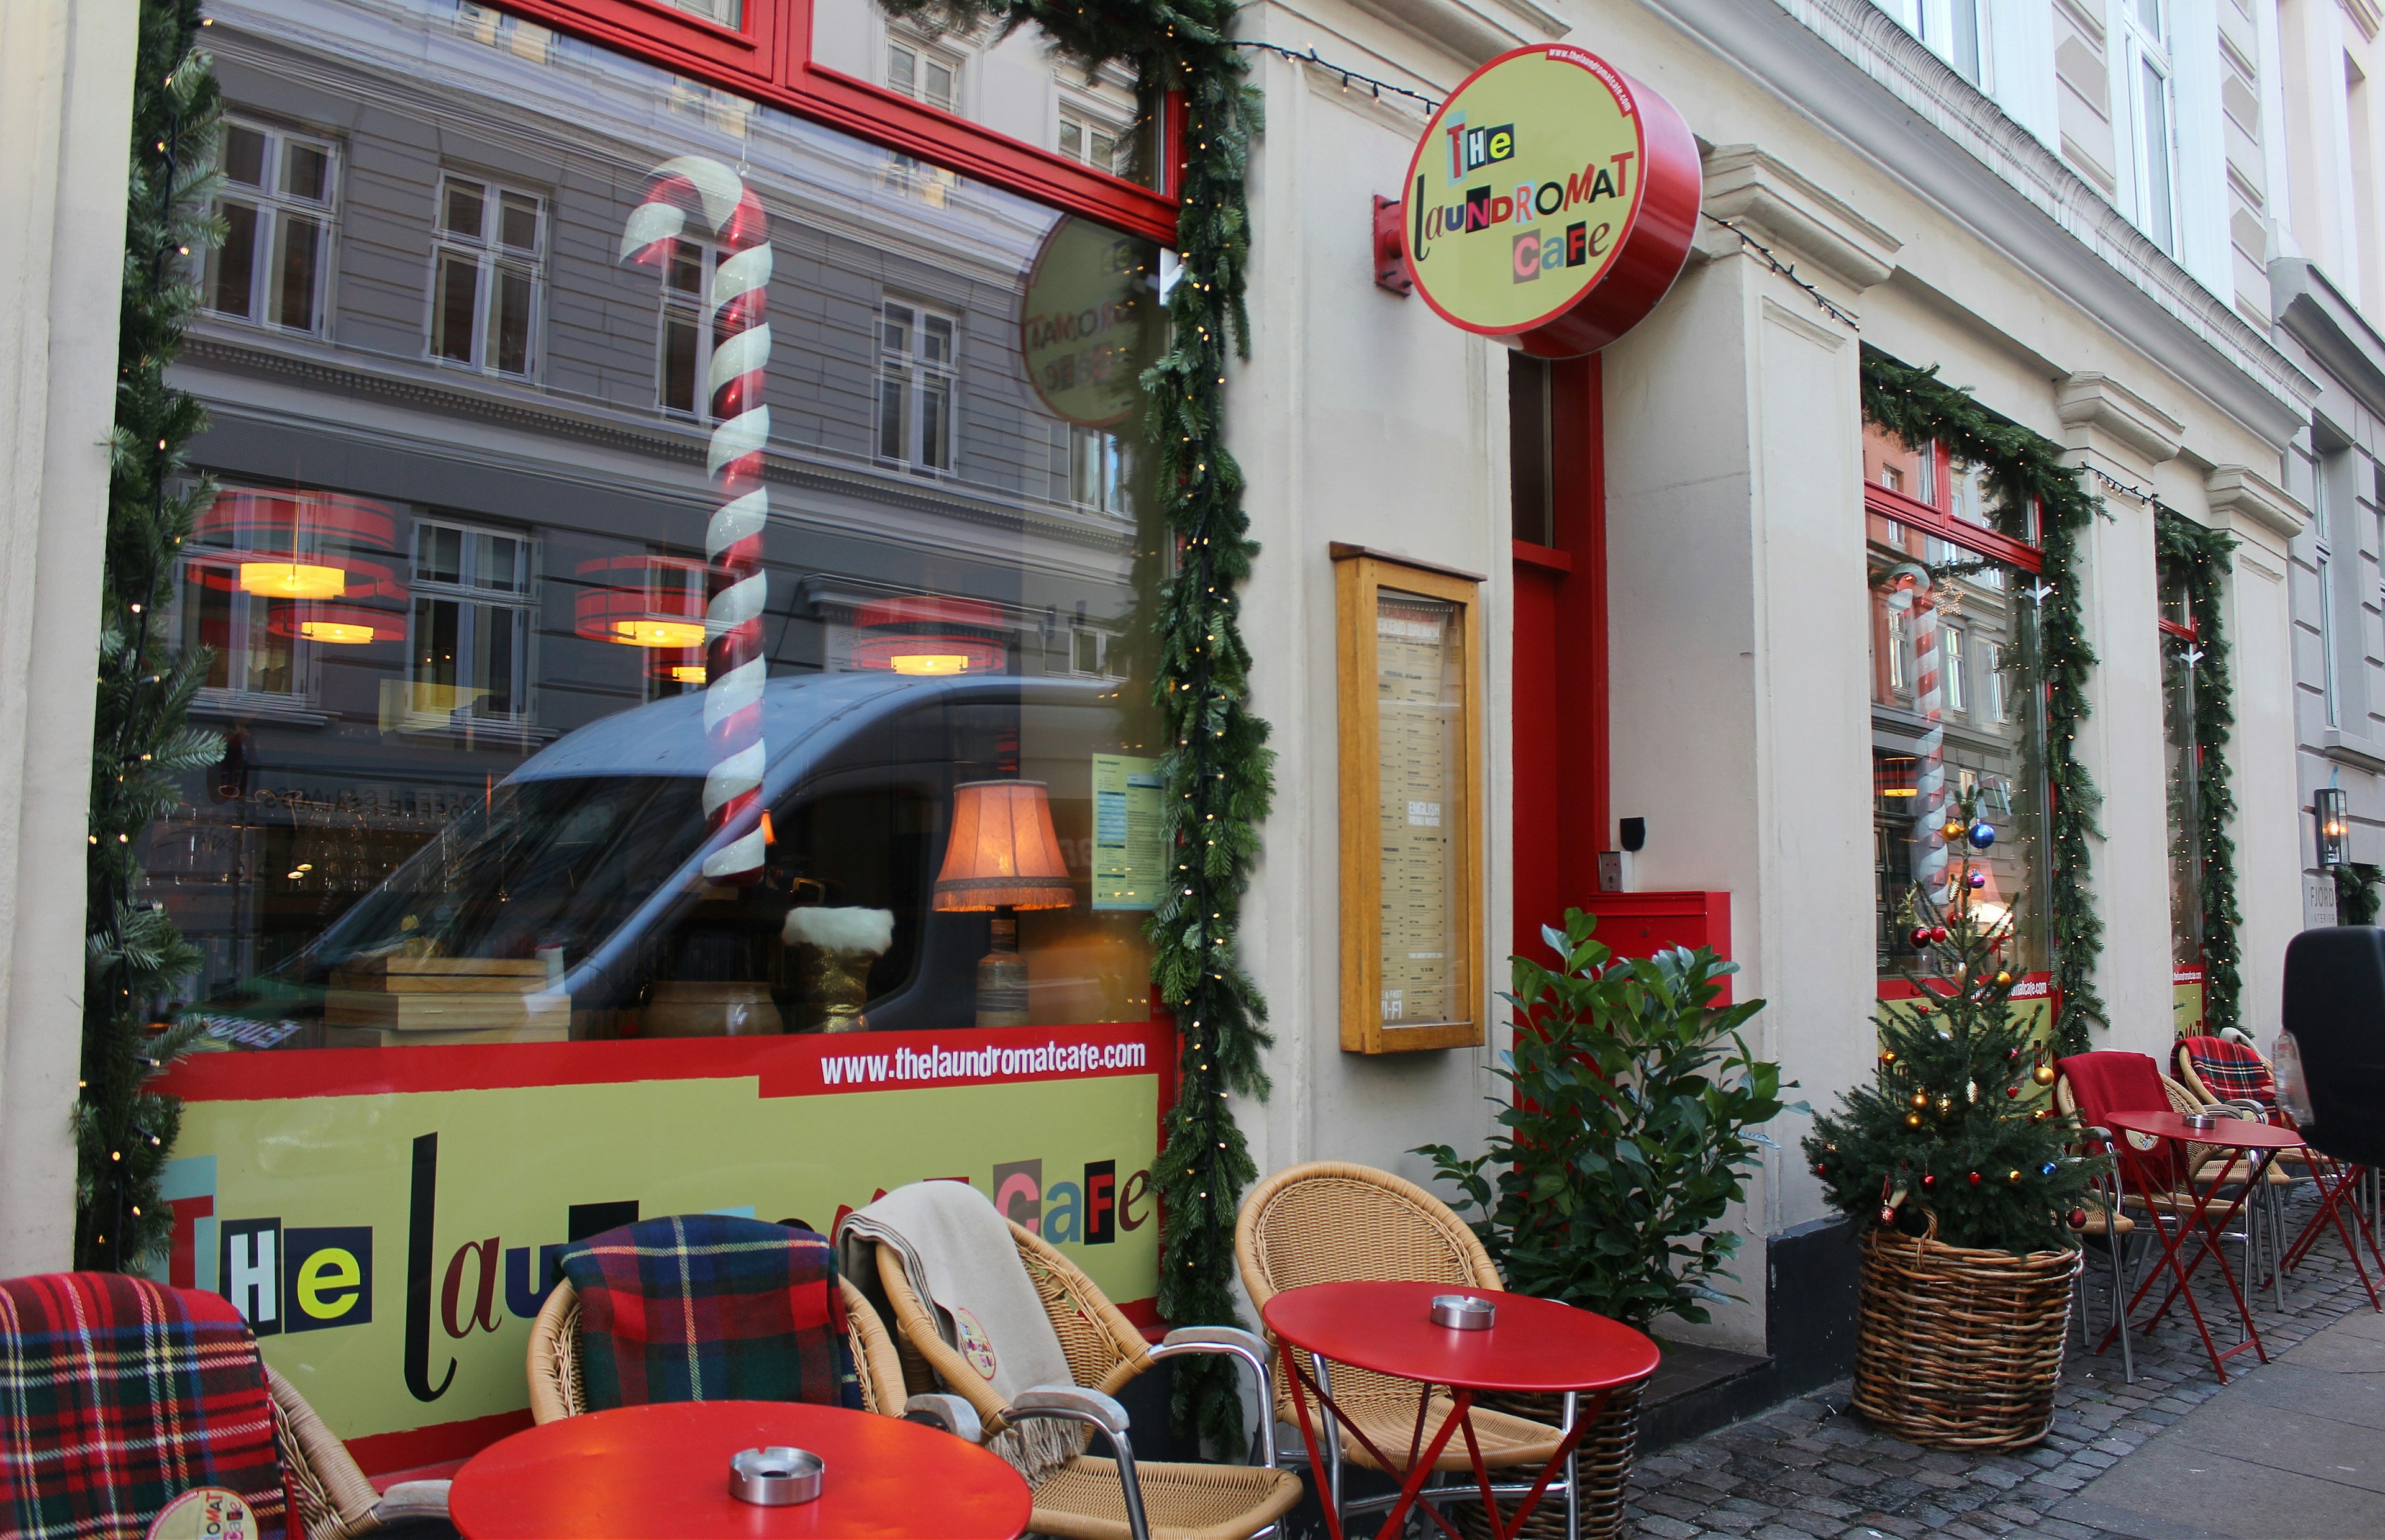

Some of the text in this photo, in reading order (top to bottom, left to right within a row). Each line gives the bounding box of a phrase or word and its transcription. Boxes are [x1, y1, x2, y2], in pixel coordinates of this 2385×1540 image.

[1549, 48, 1632, 112] www.thelaundromatcafe.com
[2310, 886, 2334, 907] FJORD
[2311, 913, 2335, 923] INTERIOR
[821, 1041, 1146, 1085] www.thelaundromatcafe.com
